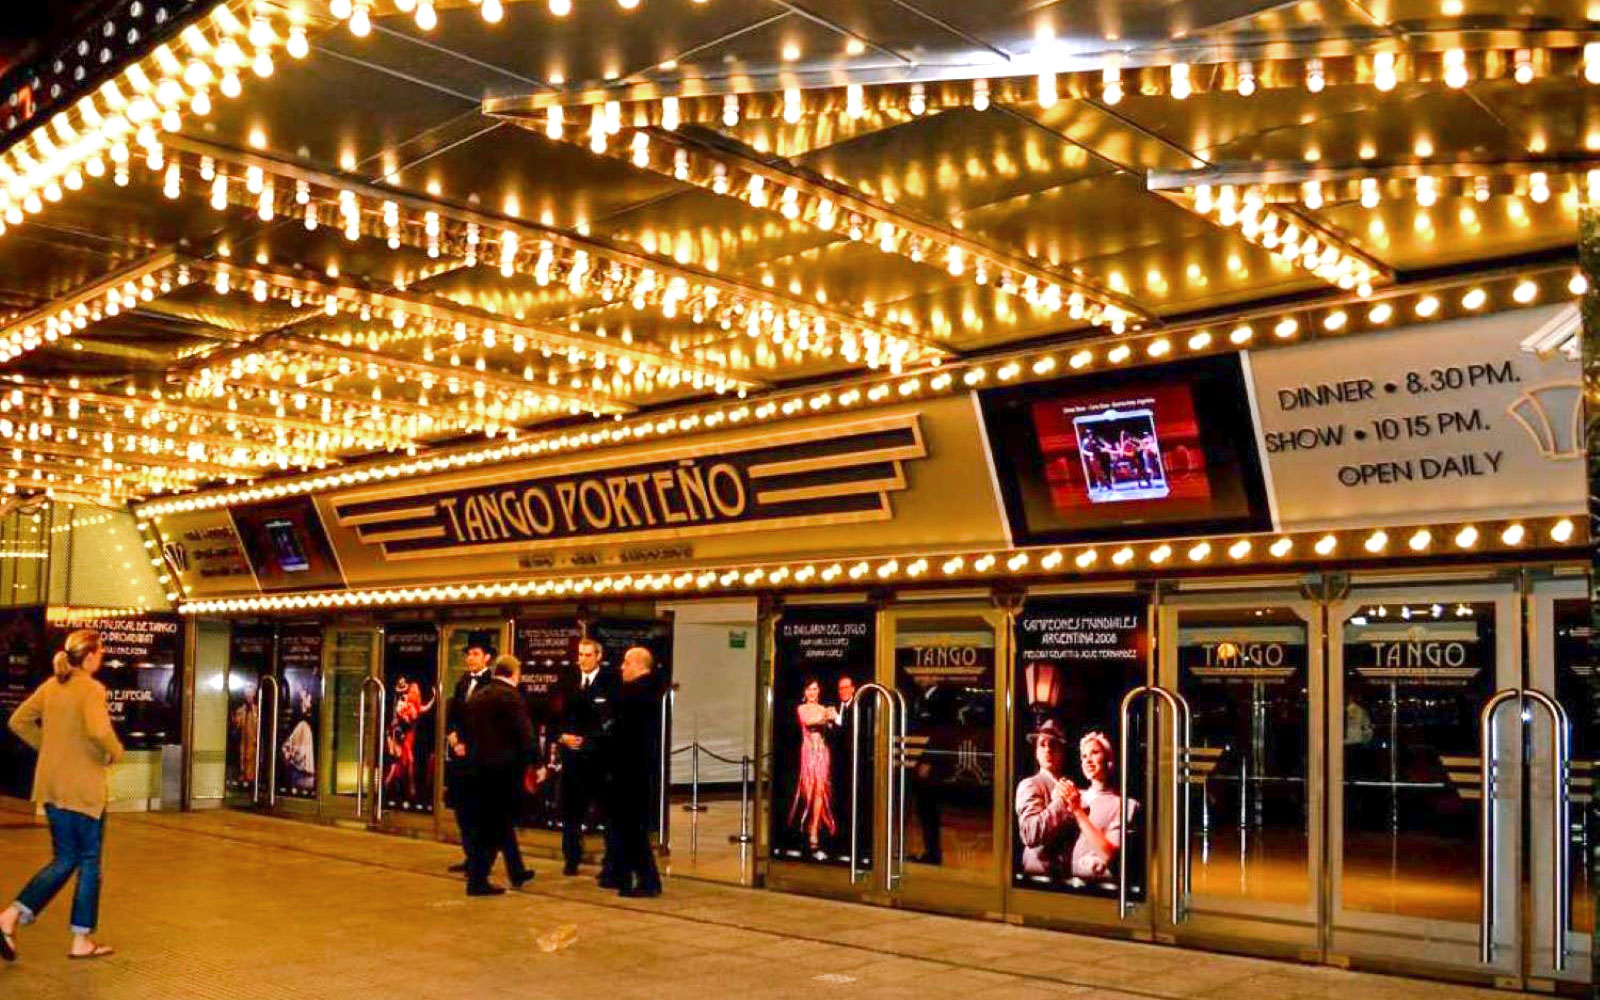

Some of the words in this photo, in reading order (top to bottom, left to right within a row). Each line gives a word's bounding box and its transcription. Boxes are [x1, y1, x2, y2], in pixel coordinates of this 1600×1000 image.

[1278, 380, 1375, 411] DINNER
[1405, 367, 1462, 394] 8.30
[1469, 360, 1521, 386] PM.
[1264, 424, 1344, 453] SHOW
[1437, 408, 1490, 434] PM.
[1337, 460, 1413, 487] OPEN
[1420, 451, 1503, 480] DAILY
[441, 486, 556, 543] TANGO
[558, 460, 747, 531] PORTEÑO
[913, 646, 977, 667] TANGO
[1042, 632, 1095, 645] ARGENTINA
[1371, 642, 1465, 667] TANGO
